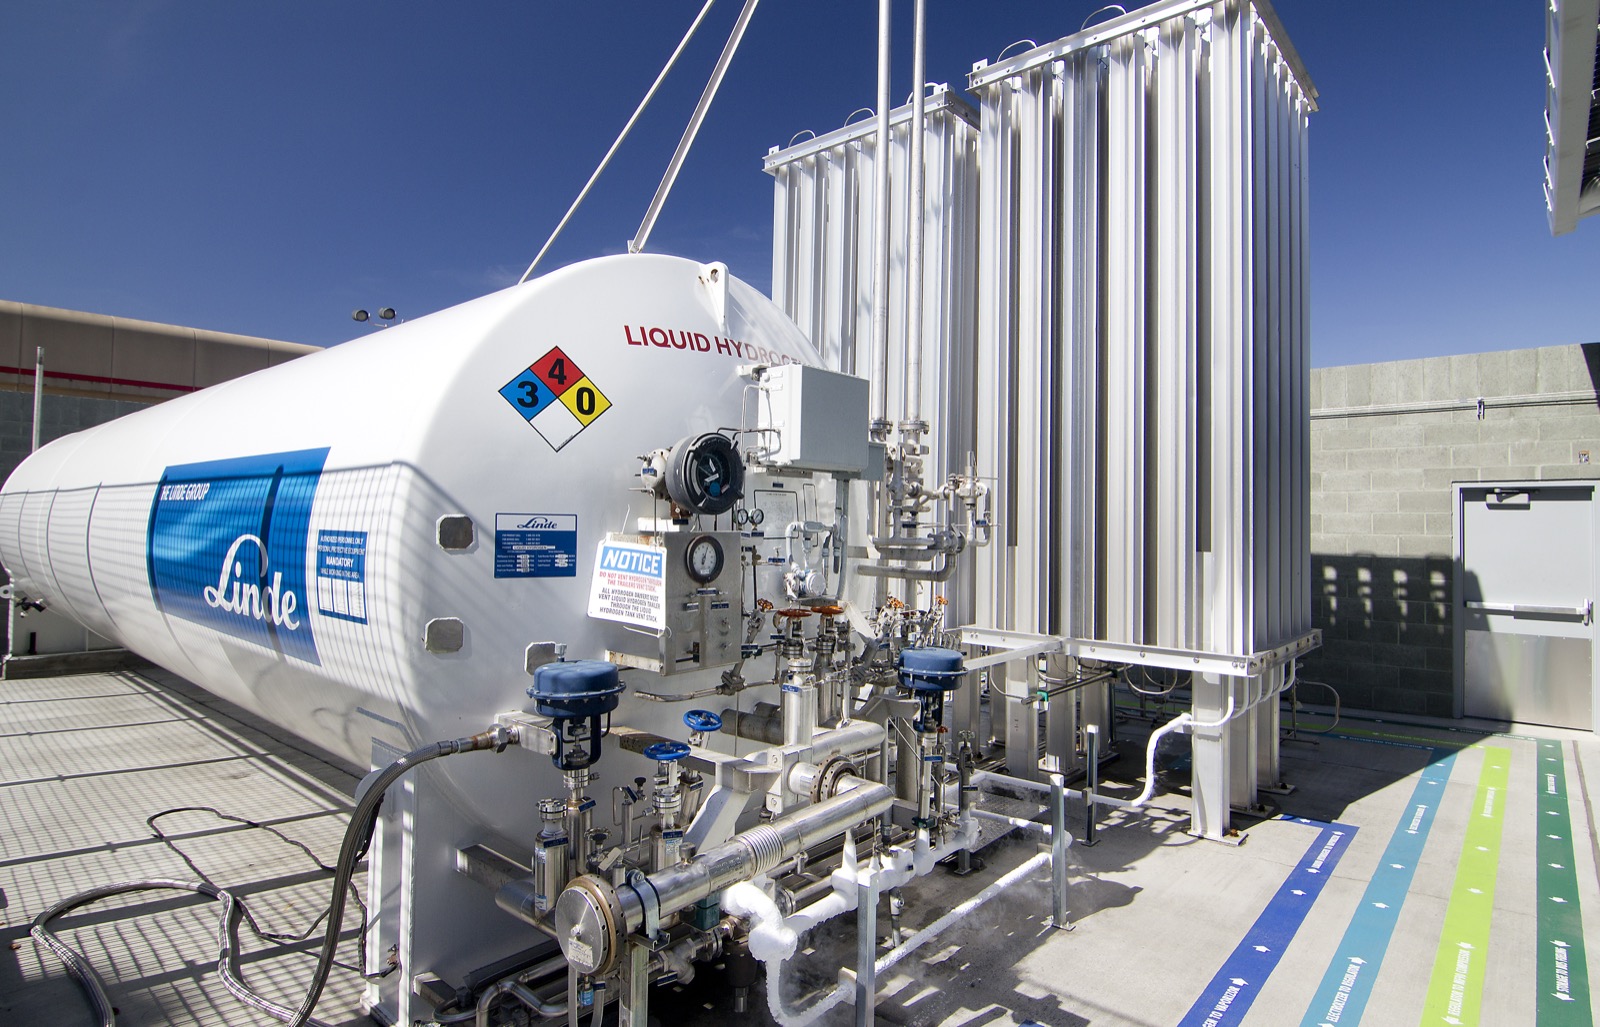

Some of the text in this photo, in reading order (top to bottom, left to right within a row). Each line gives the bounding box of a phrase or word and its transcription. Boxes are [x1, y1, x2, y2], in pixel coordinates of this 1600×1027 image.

[624, 325, 710, 353] LIQUID
[547, 358, 567, 385] 4
[516, 381, 539, 409] 3
[576, 387, 596, 416] 0
[185, 482, 210, 501] GROUP
[516, 516, 558, 530] Linde
[326, 556, 354, 568] MANDATORY
[603, 549, 661, 575] NOTICE
[204, 533, 300, 631] Linde
[611, 589, 634, 597] HYDROGEN
[611, 595, 626, 603] LIQUID
[626, 597, 647, 606] HYDROGEN
[600, 607, 624, 616] HYDROGEN
[624, 610, 635, 618] TANK
[610, 602, 631, 610] THROUGH
[639, 606, 652, 615] LIQUID
[1342, 964, 1361, 988] REGULATOR
[1338, 985, 1352, 993] TO
[1208, 1010, 1223, 1020] TO
